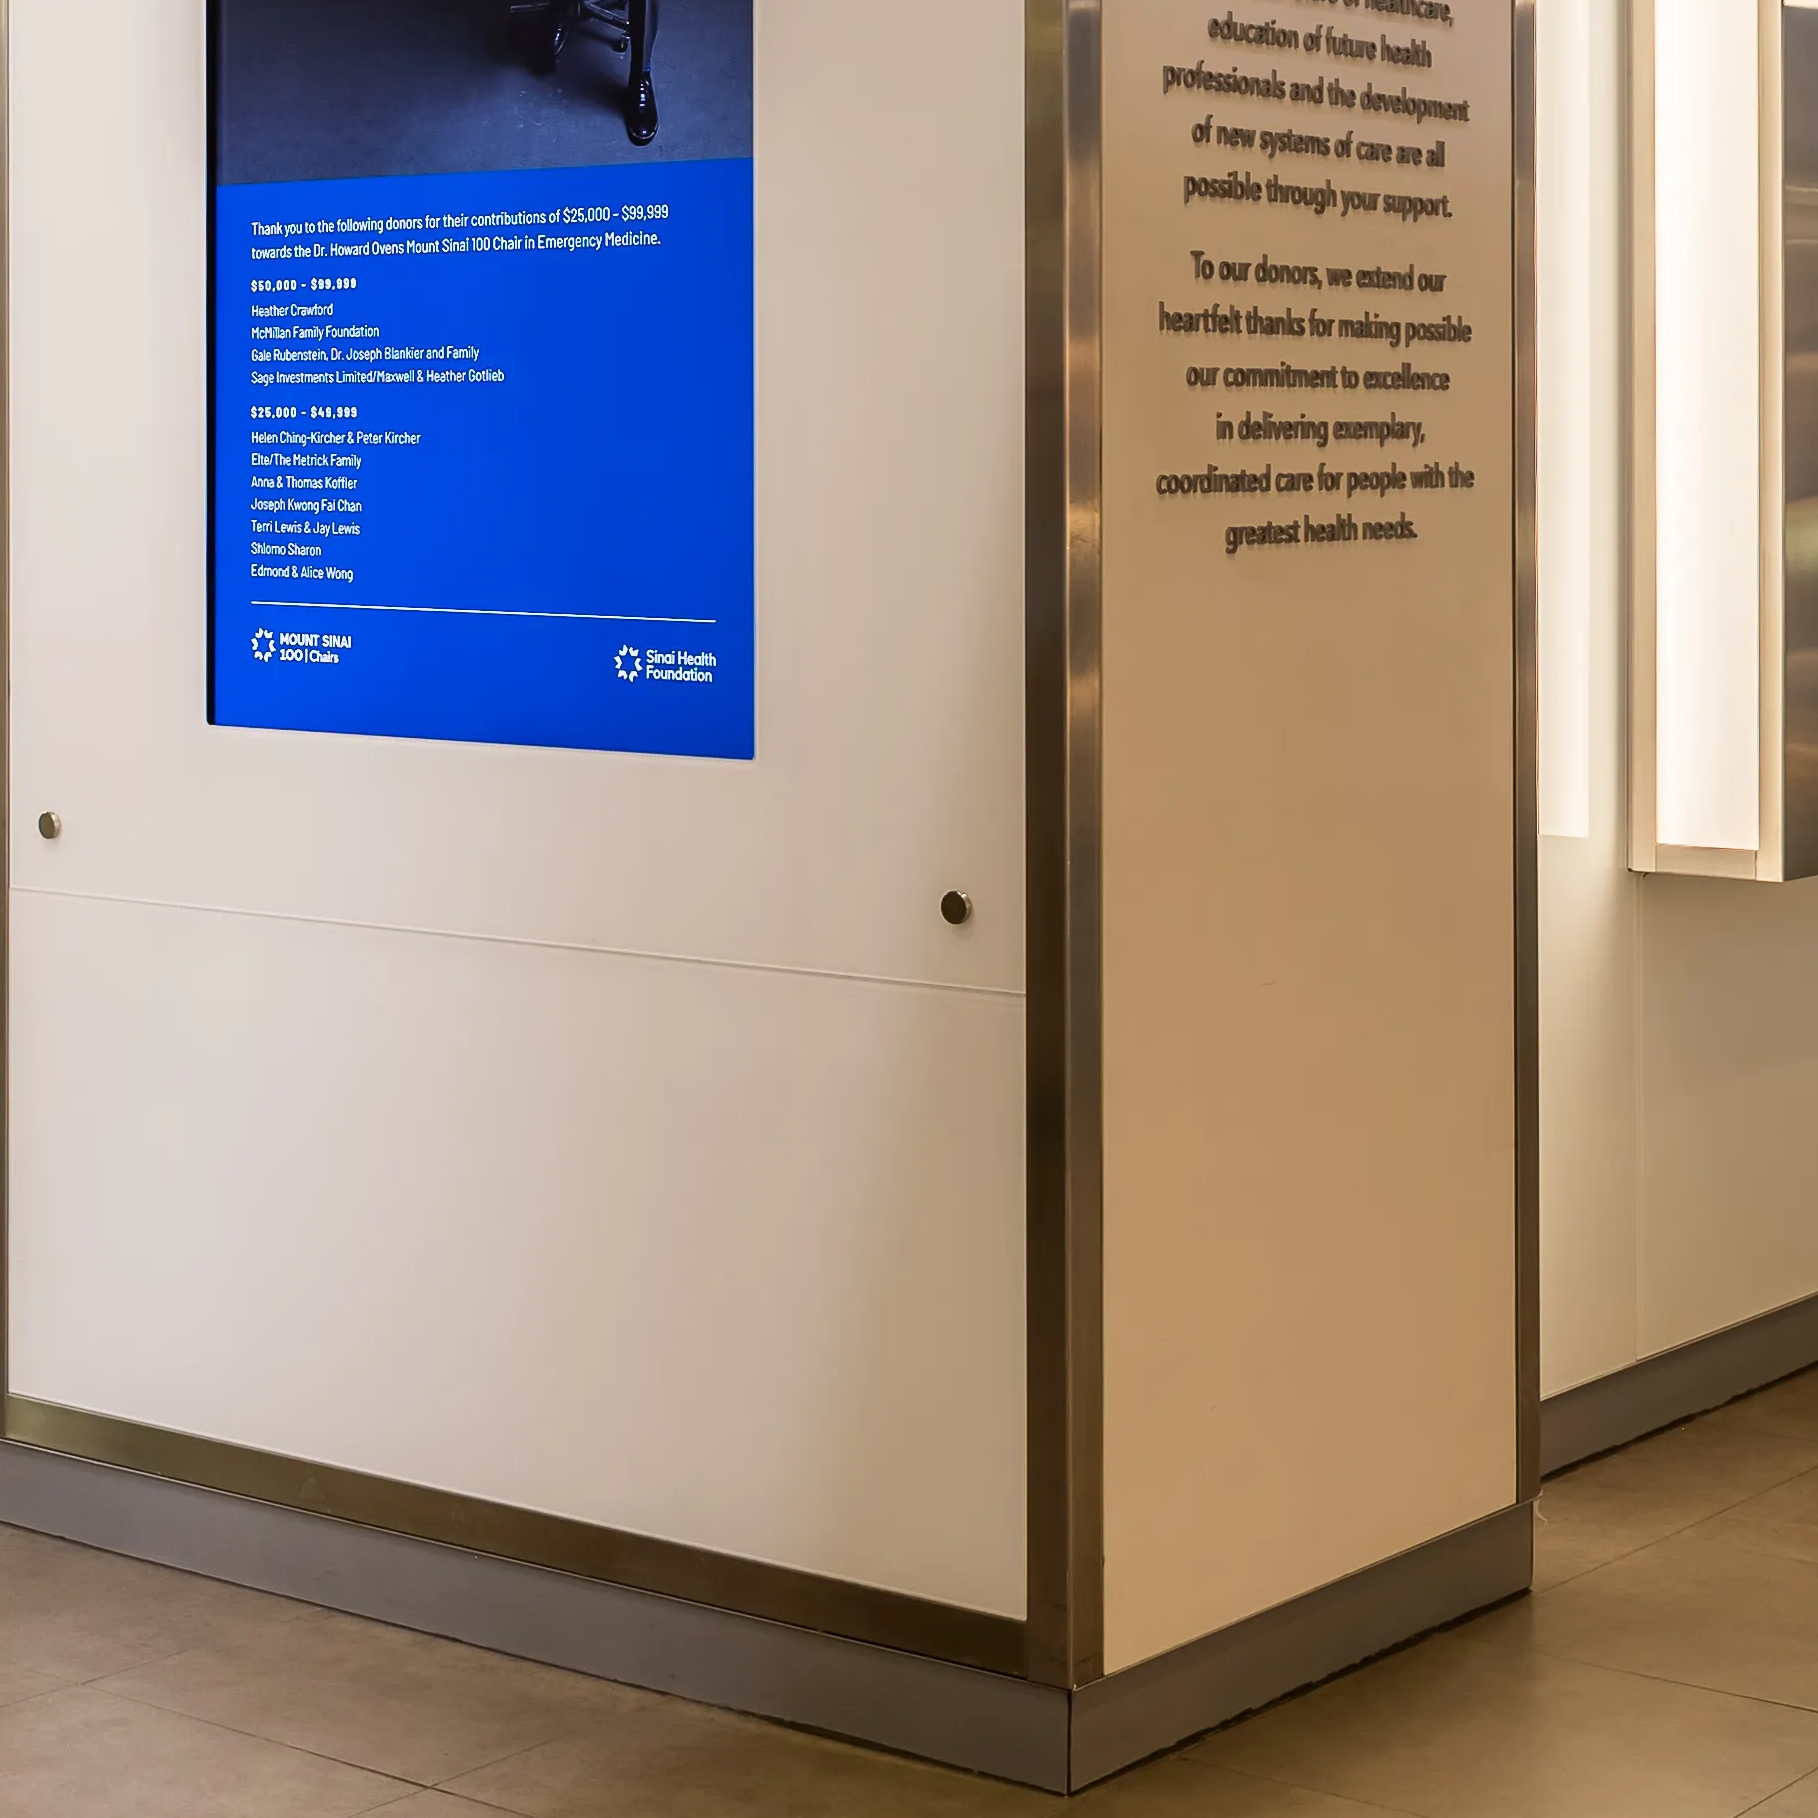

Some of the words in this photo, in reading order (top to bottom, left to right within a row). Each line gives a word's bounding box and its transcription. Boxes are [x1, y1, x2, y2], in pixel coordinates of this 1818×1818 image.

[251, 222, 283, 235] Thank
[284, 224, 302, 237] you
[305, 222, 315, 233] to
[317, 220, 334, 233] the
[337, 217, 383, 234] following
[386, 217, 423, 230] donors
[425, 215, 441, 228] for
[443, 213, 469, 227] their
[471, 211, 546, 226] contributions
[549, 209, 560, 223] of
[563, 207, 610, 223] $25,000
[622, 205, 668, 221] $99,999
[252, 245, 292, 259] towards
[294, 245, 311, 257] the
[314, 244, 327, 257] Dr.
[330, 242, 369, 256] Howard
[372, 241, 404, 255] Ovens
[407, 240, 439, 253] Mount
[442, 237, 469, 252] Sinai
[472, 237, 490, 251] 100
[493, 236, 522, 250] Chair
[525, 235, 535, 249] in
[538, 235, 602, 251] Emergency
[605, 231, 661, 246] Medicine.
[1191, 249, 1214, 280] To
[1219, 259, 1251, 281] our
[1255, 253, 1322, 288] donors,
[1326, 266, 1352, 287] we
[1356, 263, 1414, 290] extend
[1418, 272, 1446, 292] our
[251, 280, 296, 292] $50,000
[311, 278, 356, 290] $99,999
[252, 305, 289, 317] Heather
[291, 303, 333, 316] Crawford
[1159, 301, 1242, 333] heartfelt
[1245, 305, 1305, 336] thanks
[1308, 307, 1335, 337] for
[1339, 310, 1401, 347] making
[1405, 314, 1472, 346] possible
[279, 632, 320, 647] MOUNT
[322, 634, 352, 648] SINAI
[646, 649, 675, 665] Sinai
[677, 650, 717, 667] Health
[646, 665, 713, 683] Foundation
